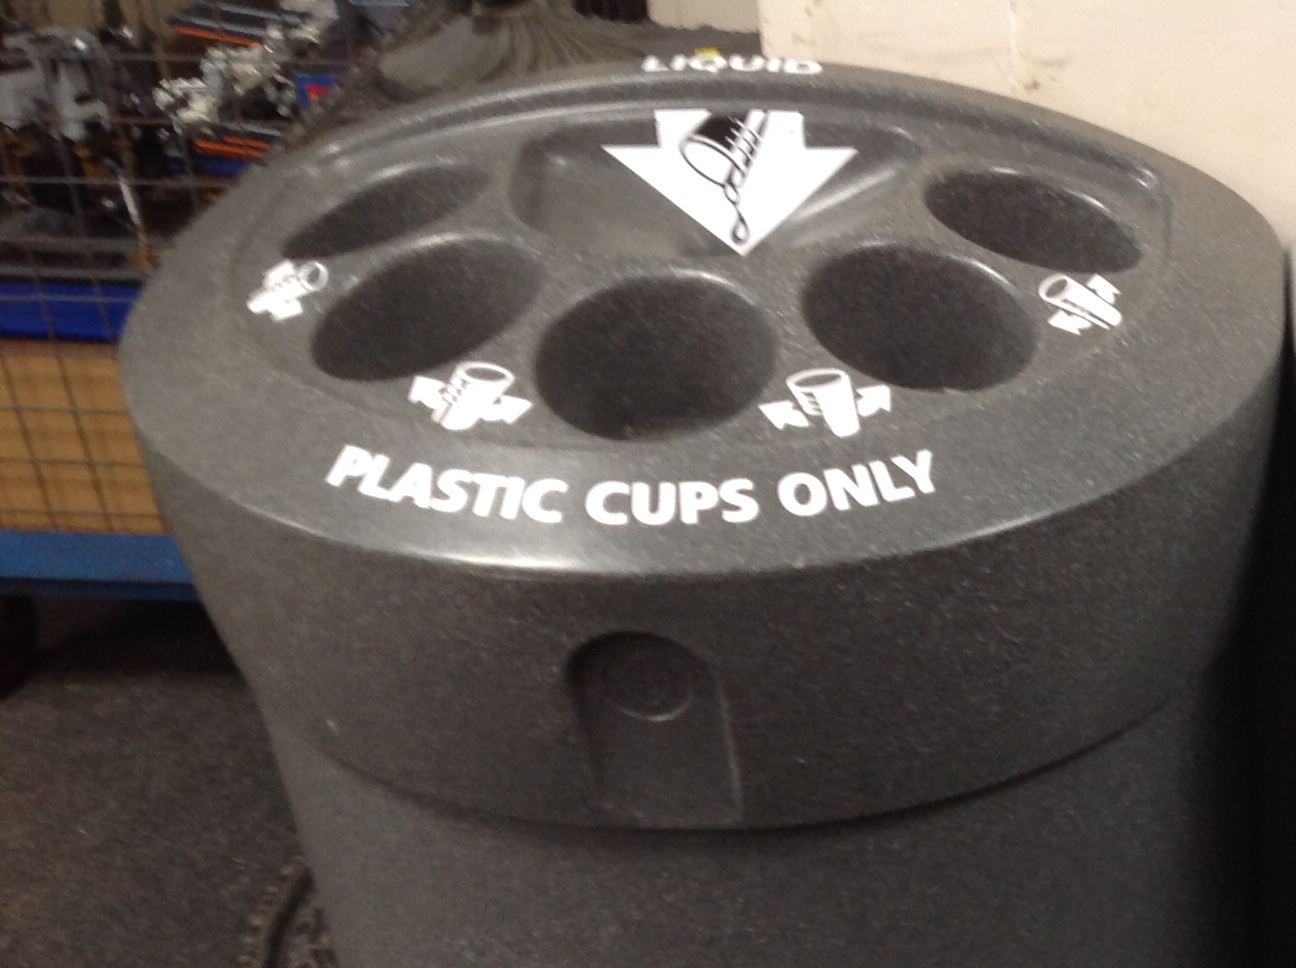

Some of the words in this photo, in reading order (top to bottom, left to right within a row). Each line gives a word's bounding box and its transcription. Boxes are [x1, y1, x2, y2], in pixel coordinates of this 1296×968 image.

[641, 53, 823, 74] LIQUID
[326, 445, 568, 524] PLASTIC
[585, 478, 760, 525] CUPS
[777, 449, 937, 516] ONLY
